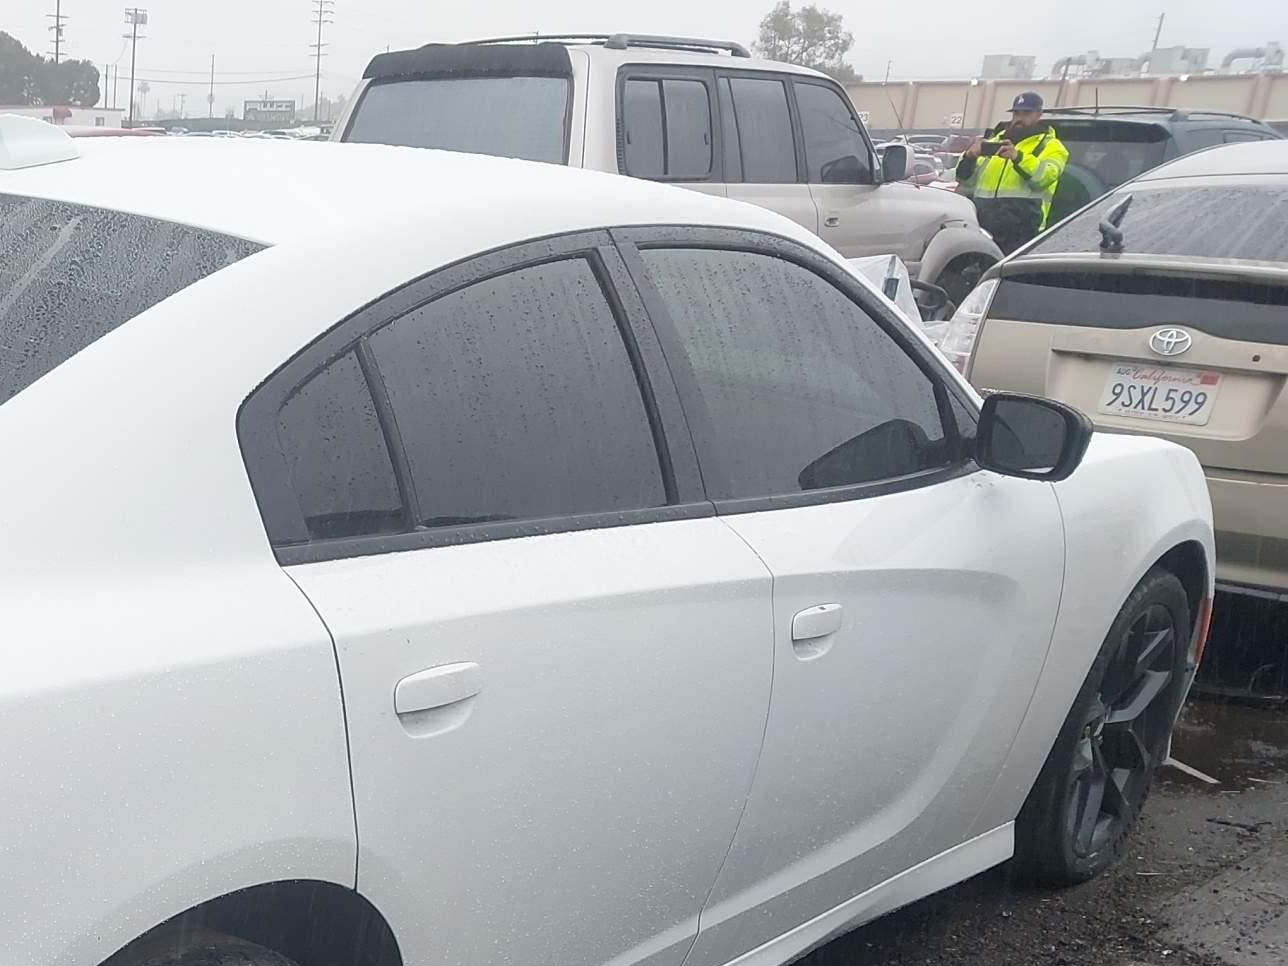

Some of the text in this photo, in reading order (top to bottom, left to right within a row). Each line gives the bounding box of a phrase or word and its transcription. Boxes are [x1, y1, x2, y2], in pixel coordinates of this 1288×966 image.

[951, 115, 962, 125] 22
[1132, 367, 1197, 386] California
[1105, 382, 1208, 416] 9SXL599
